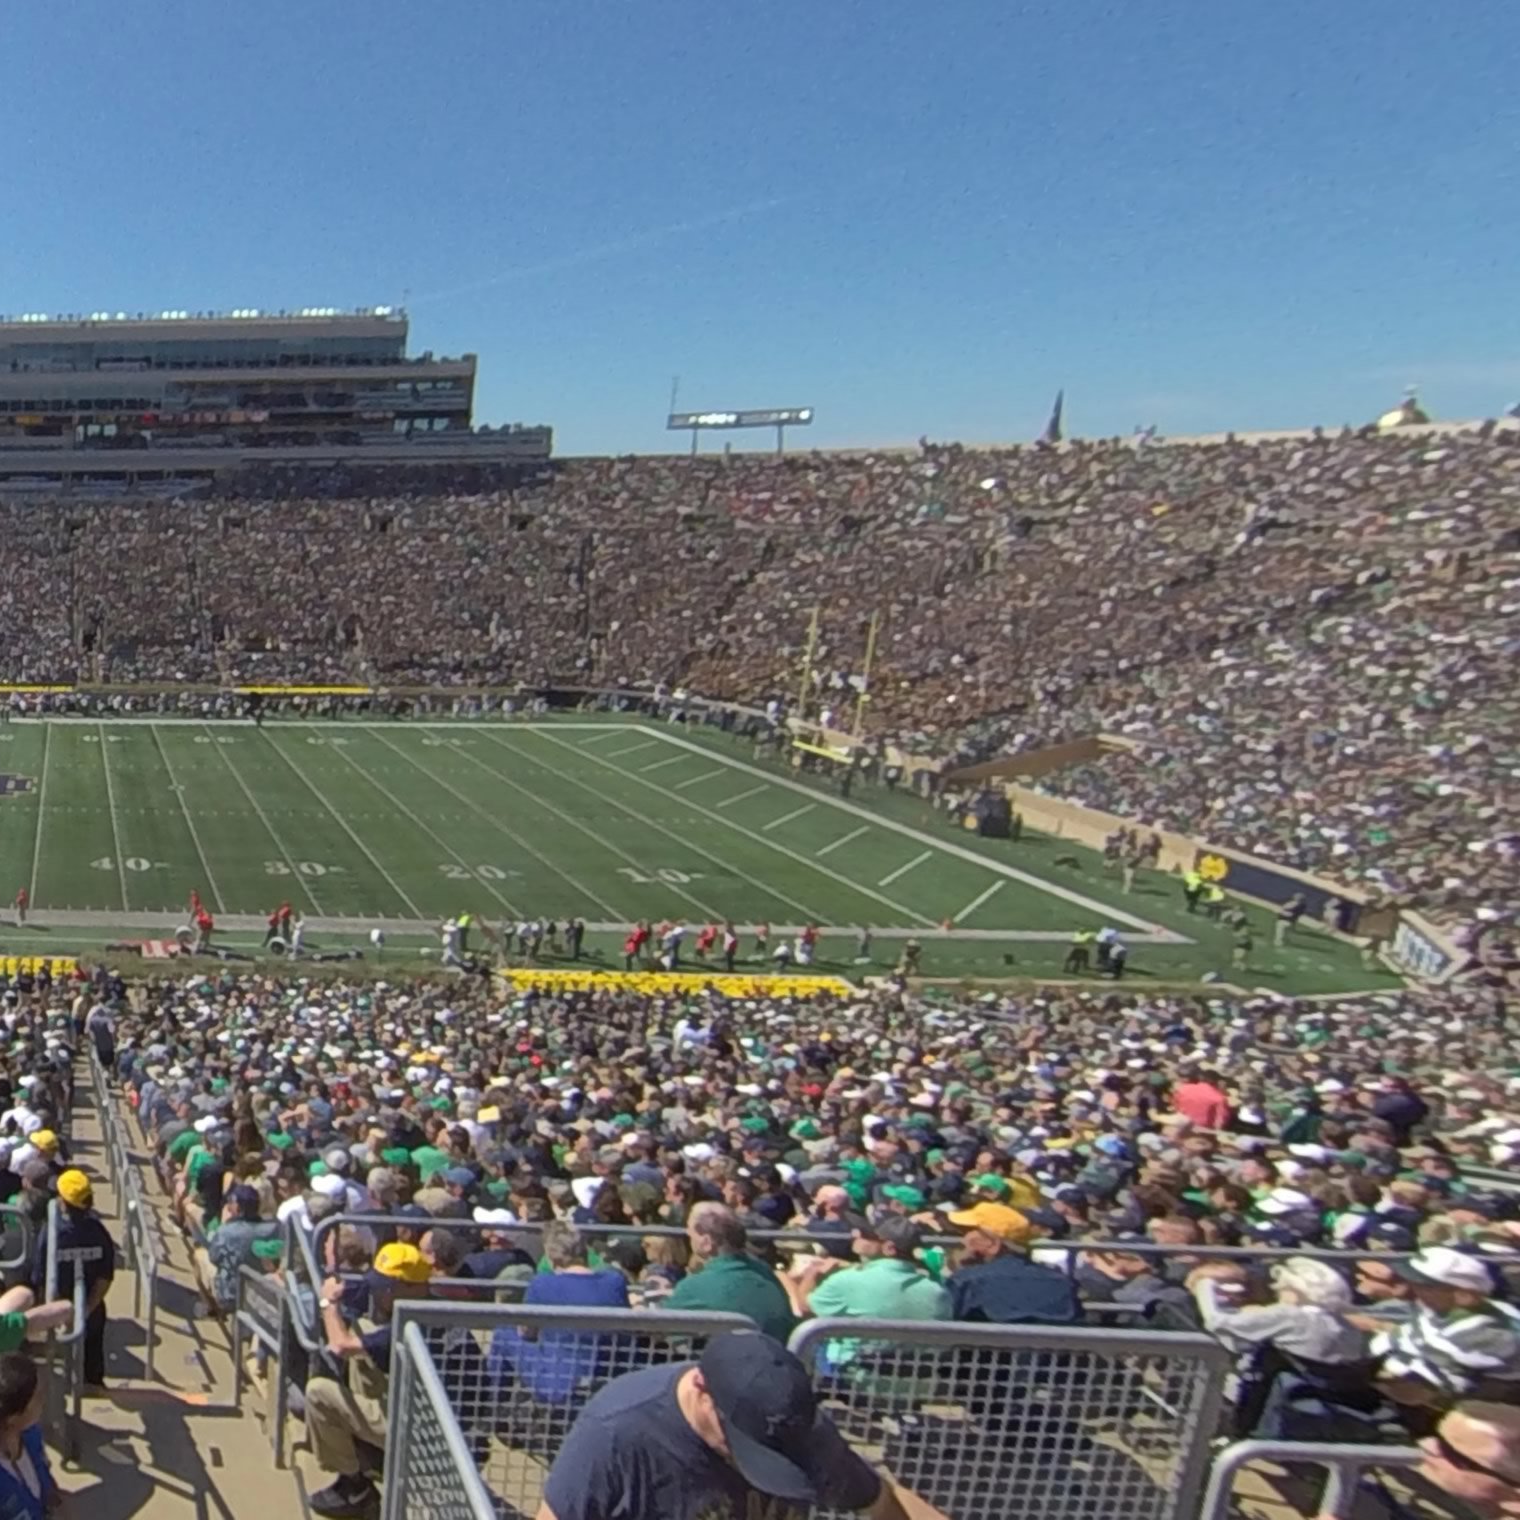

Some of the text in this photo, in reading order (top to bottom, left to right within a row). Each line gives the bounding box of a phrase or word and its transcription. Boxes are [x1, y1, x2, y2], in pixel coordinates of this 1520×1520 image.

[89, 857, 151, 871] 40
[264, 861, 326, 876] 30
[438, 864, 507, 879] 20
[616, 867, 691, 883] 10
